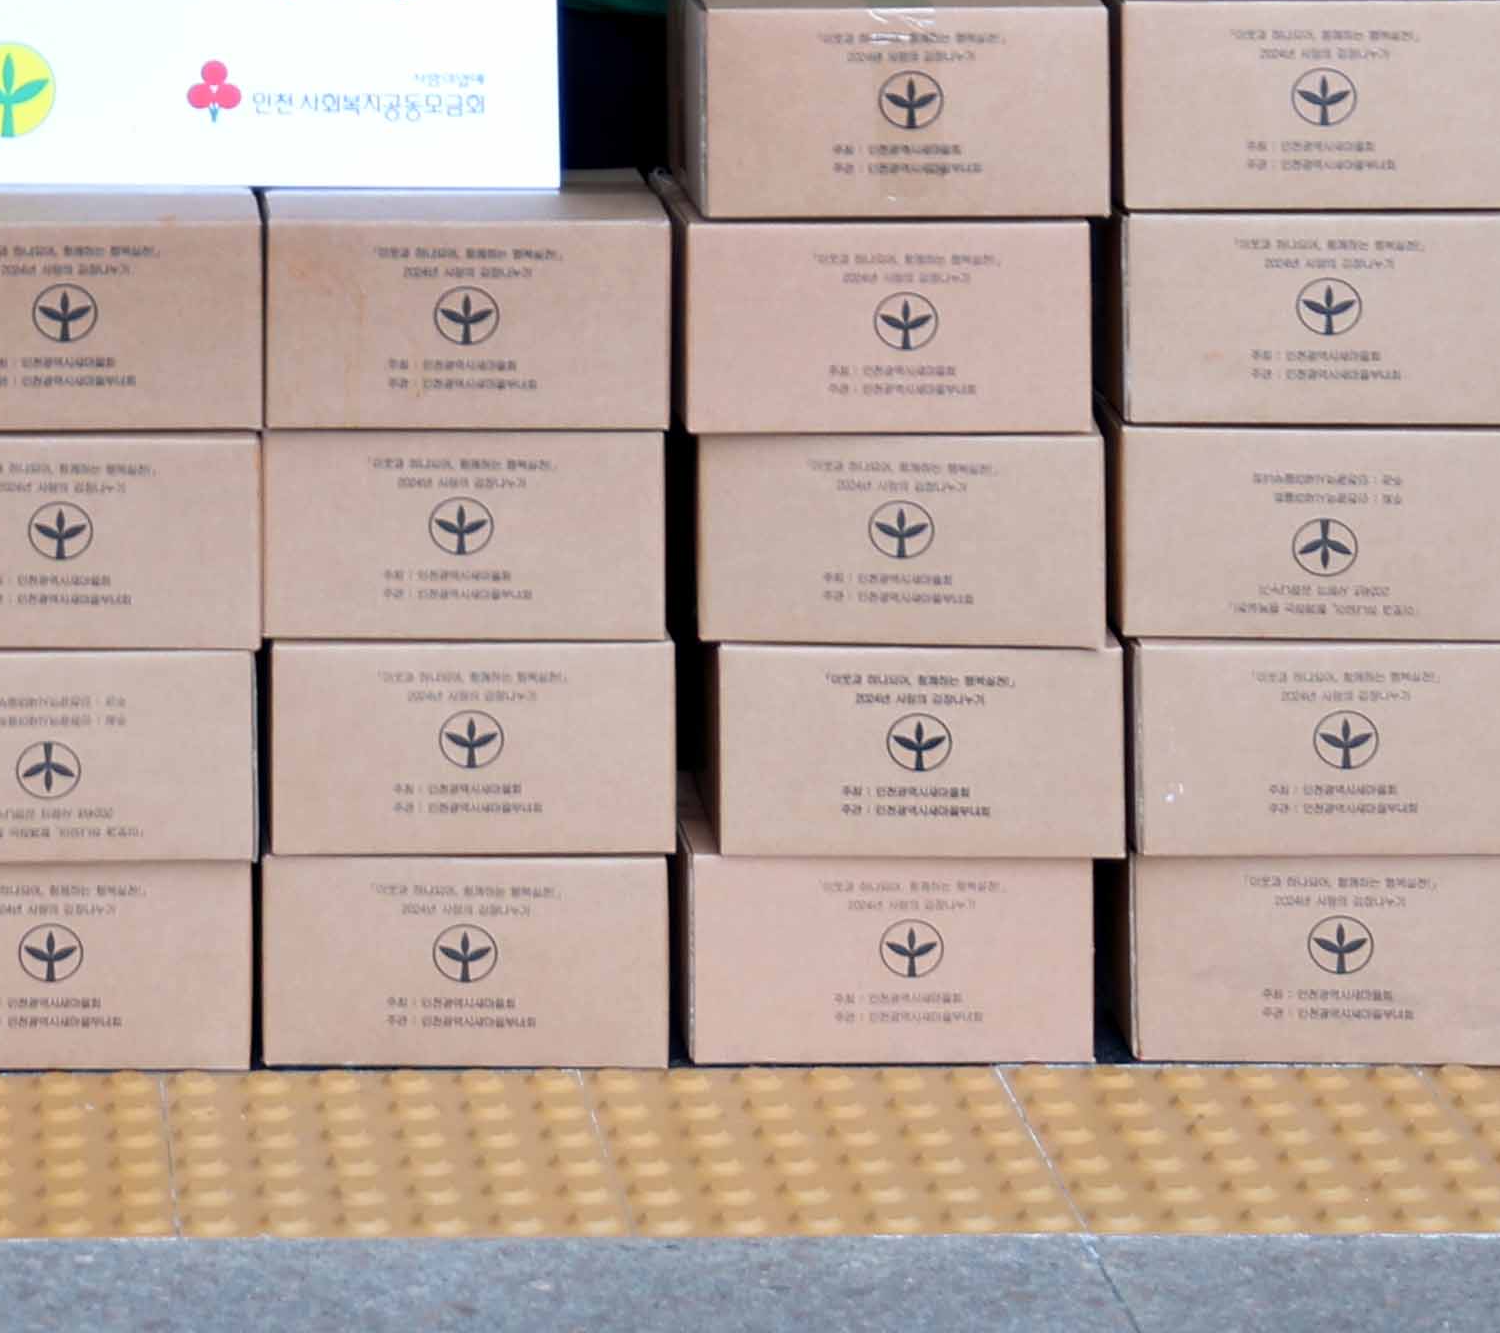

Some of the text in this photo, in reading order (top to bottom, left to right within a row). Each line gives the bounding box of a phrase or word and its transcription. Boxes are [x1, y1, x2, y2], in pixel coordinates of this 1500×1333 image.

[252, 92, 294, 116] 인천
[917, 674, 960, 687] 함께하는
[855, 692, 986, 706] 2024년 사랑의 김장나누기
[875, 785, 971, 798] 인천광역시새마을회
[875, 803, 991, 817] 인천광역시새마을부녀회
